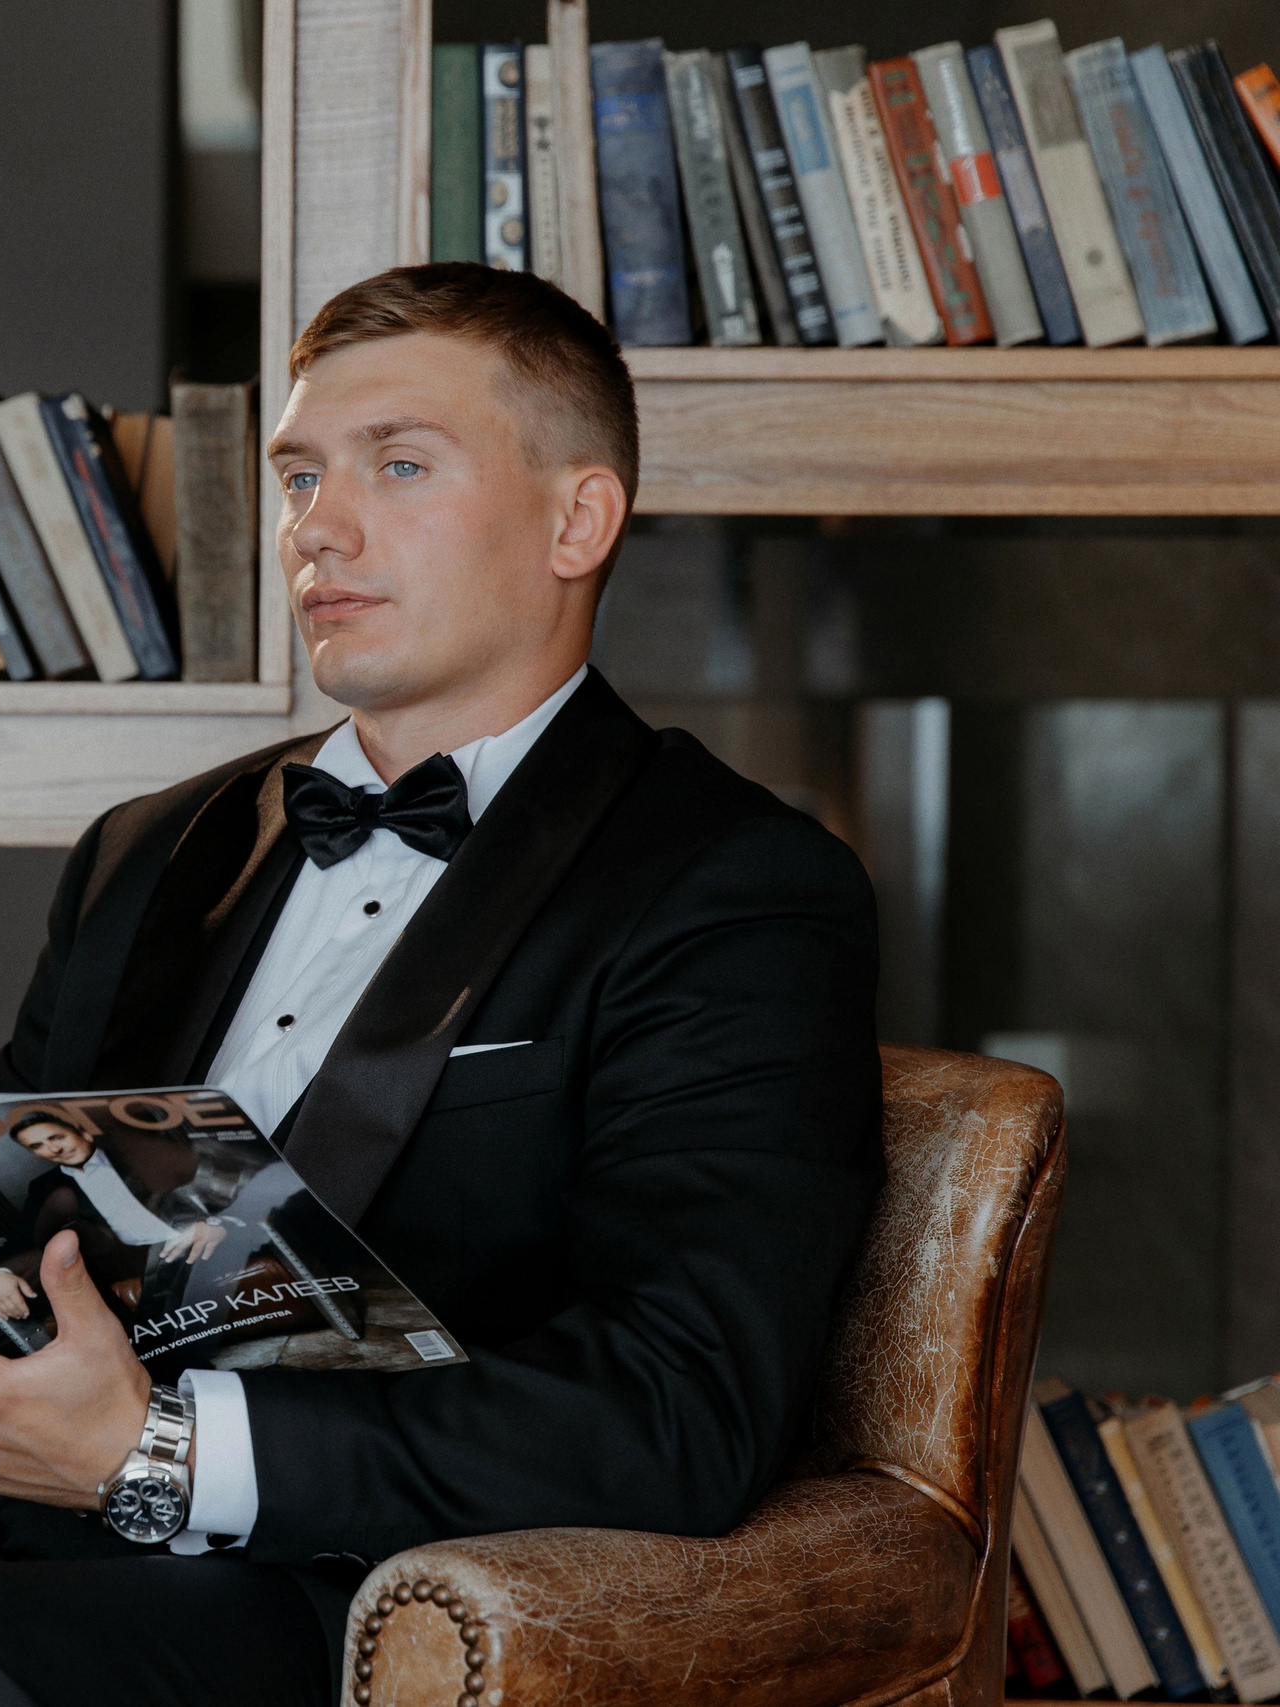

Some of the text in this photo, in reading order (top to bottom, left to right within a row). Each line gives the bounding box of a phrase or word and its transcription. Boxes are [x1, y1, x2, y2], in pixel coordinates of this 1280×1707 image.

[129, 1276, 360, 1344] АНДР КАЛЕЕВ
[138, 1309, 293, 1361] МУЛА УСПЕШНОГО ЛИДЕРСТВА
